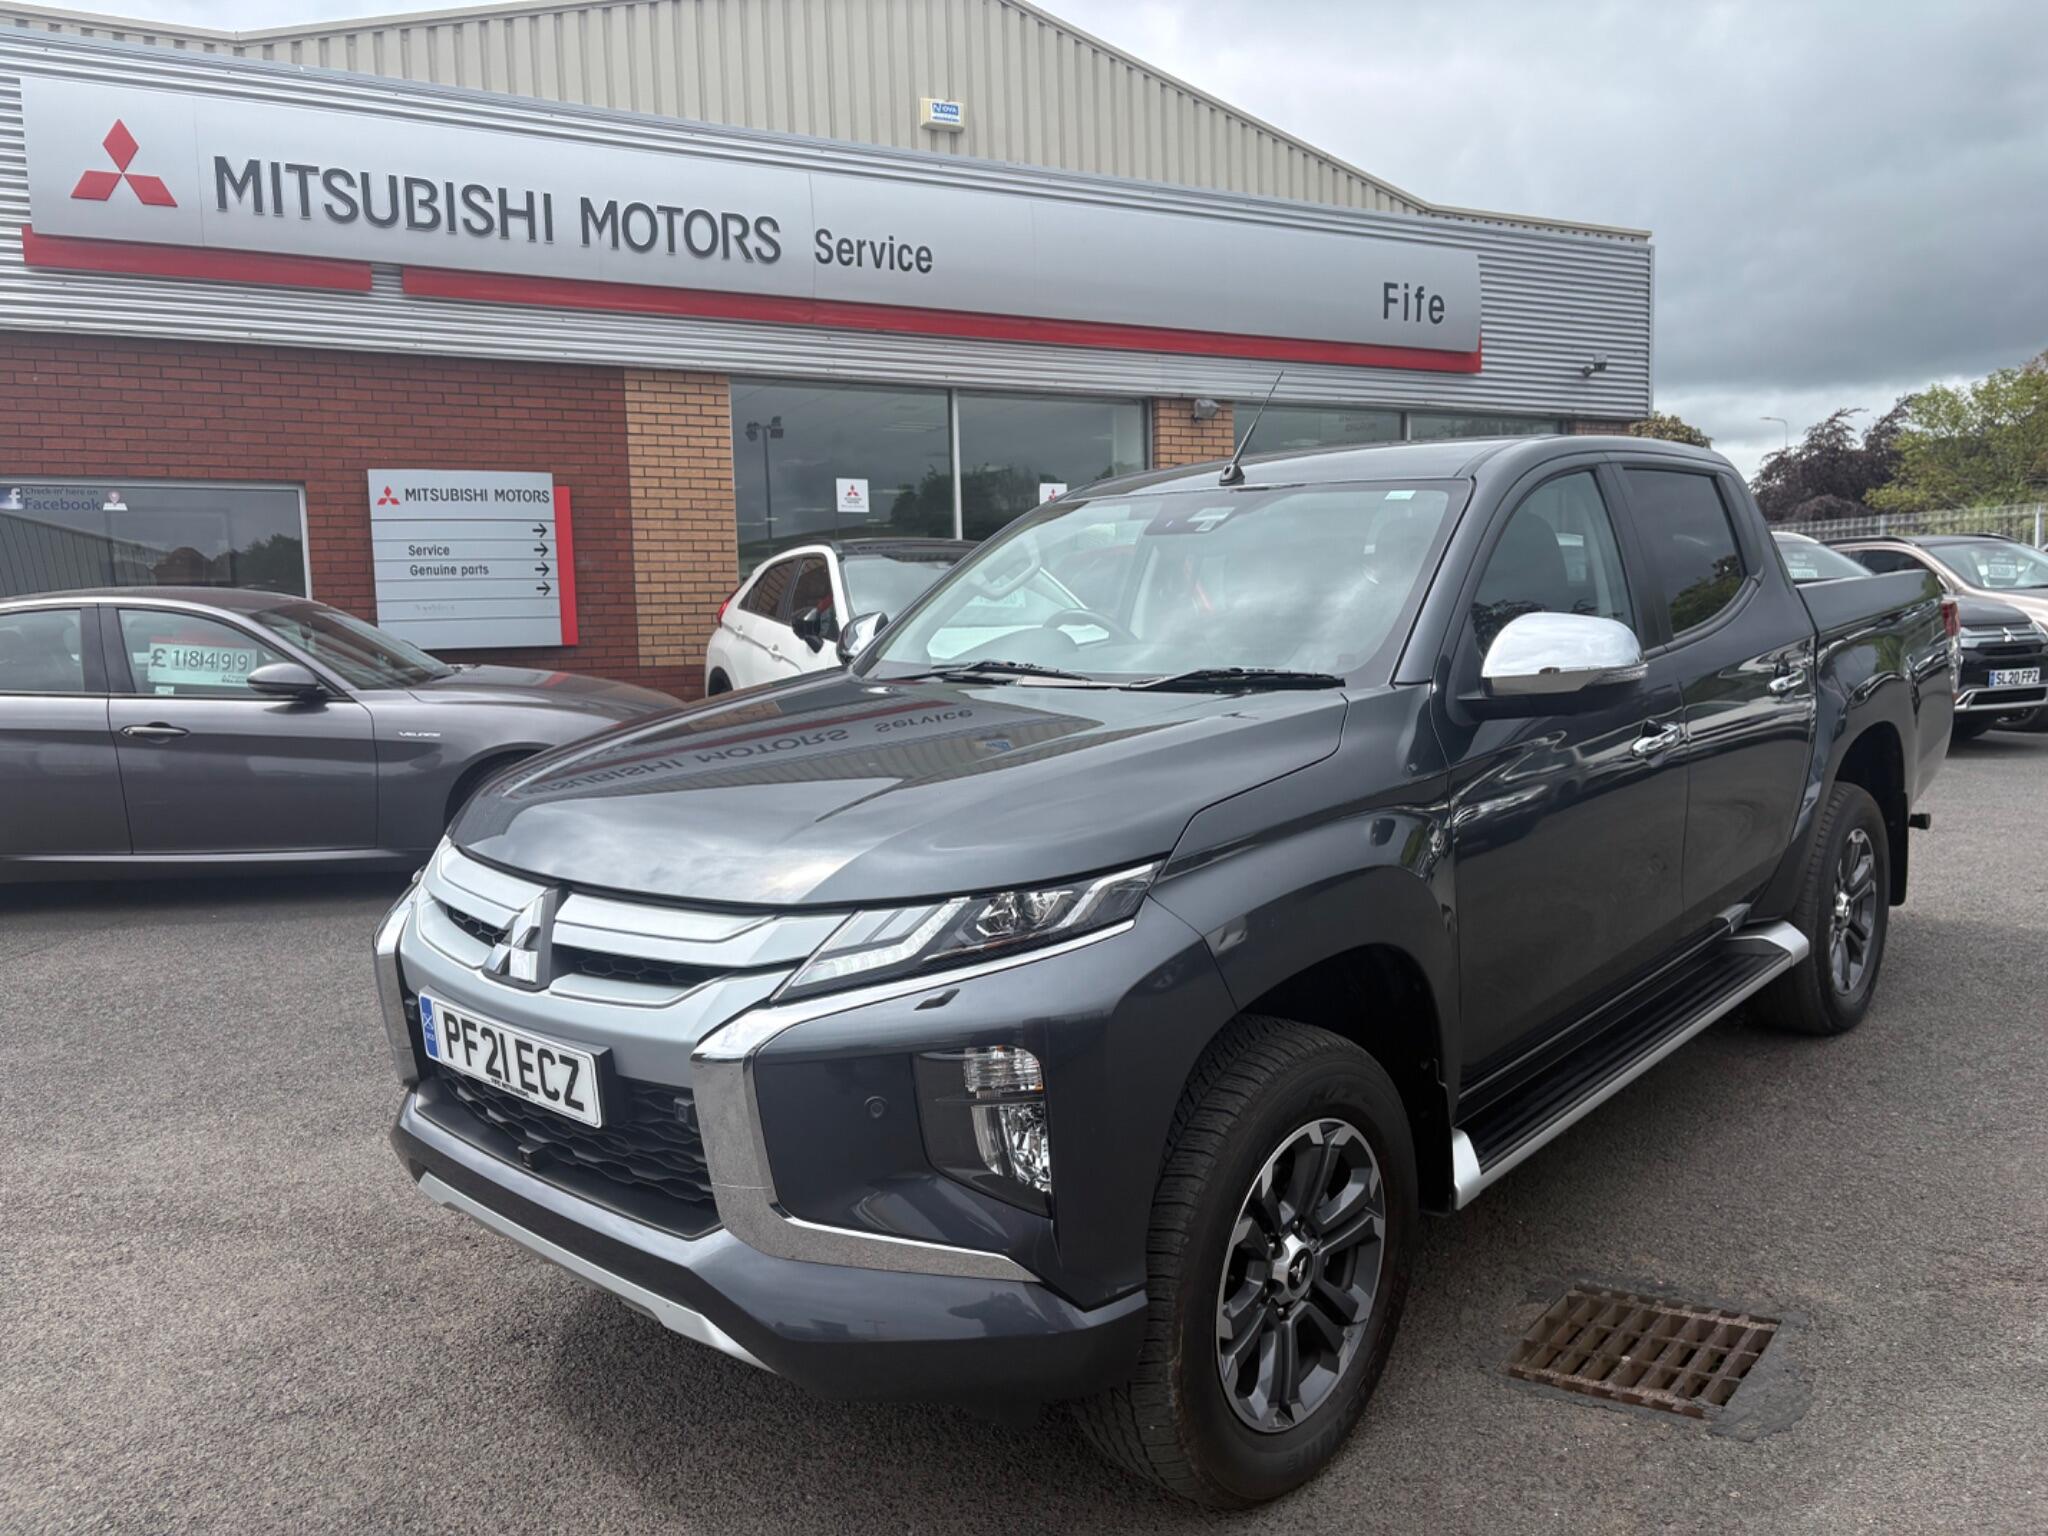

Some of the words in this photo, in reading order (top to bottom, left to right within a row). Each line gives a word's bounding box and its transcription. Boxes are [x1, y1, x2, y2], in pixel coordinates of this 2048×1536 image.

[213, 155, 553, 244] MITSUBISHI
[579, 196, 783, 265] MOTORS
[814, 228, 933, 274] Service
[1383, 281, 1445, 325] Fife
[404, 488, 488, 502] MITSUBISHI
[494, 488, 550, 503] MOTORS
[24, 497, 101, 511] Facebook
[408, 544, 450, 557] Service
[409, 564, 457, 576] Genuine
[460, 564, 490, 578] parts
